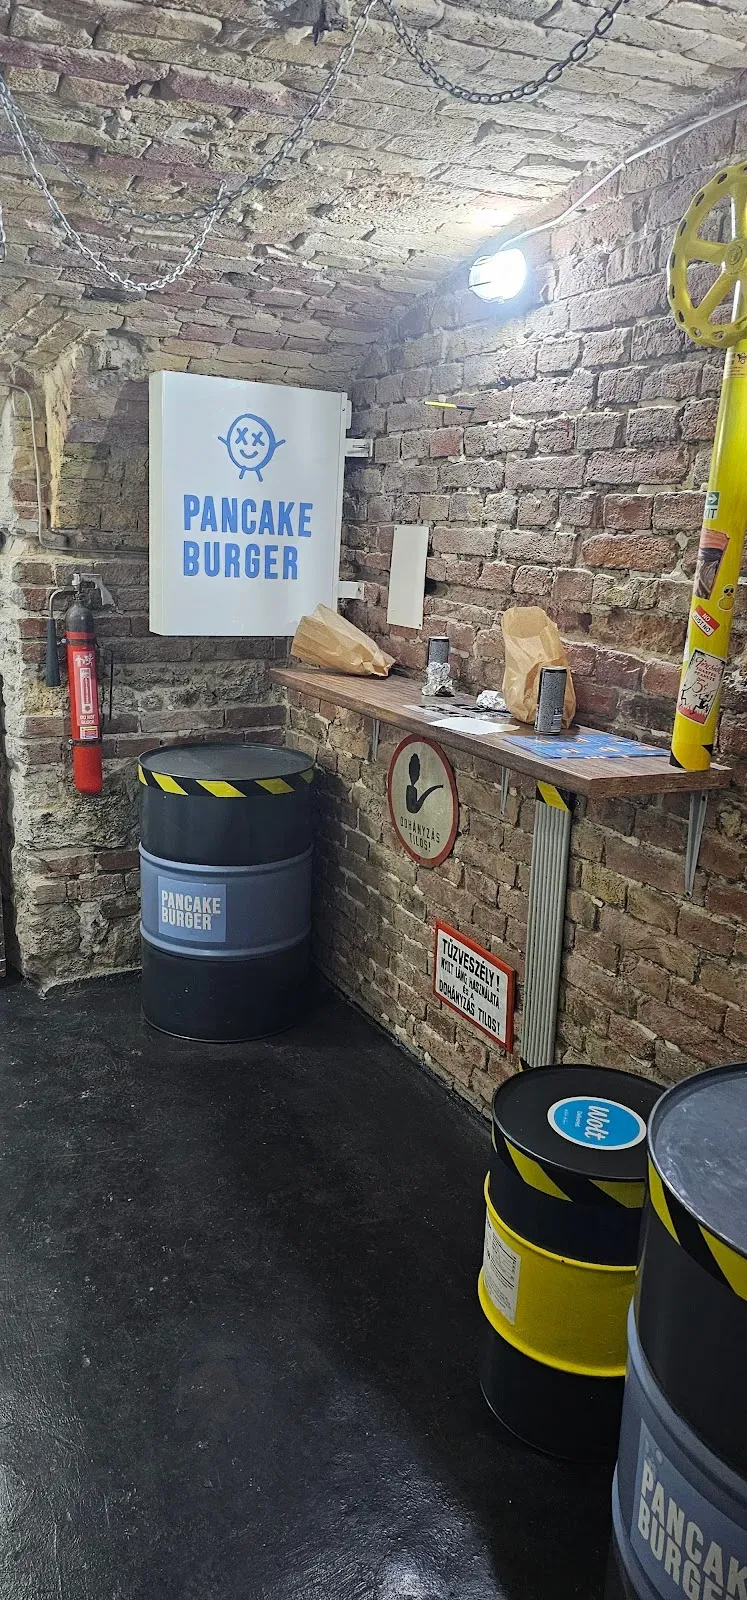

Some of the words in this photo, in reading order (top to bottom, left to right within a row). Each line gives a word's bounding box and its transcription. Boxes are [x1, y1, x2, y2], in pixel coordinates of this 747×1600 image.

[183, 494, 313, 538] PANCAKE
[183, 540, 298, 580] BURGER
[702, 612, 711, 622] NO
[400, 816, 440, 844] DOHÁNYZÁS
[409, 832, 431, 853] TILOS!
[161, 890, 221, 915] PANCAKE
[161, 906, 212, 931] BURGER
[439, 978, 475, 1017] DOHÁNYZÁS
[477, 1006, 501, 1036] TILOS!
[584, 1105, 610, 1140] Wolt
[640, 1459, 747, 1598] PANCAK
[638, 1495, 738, 1600] BURGE
